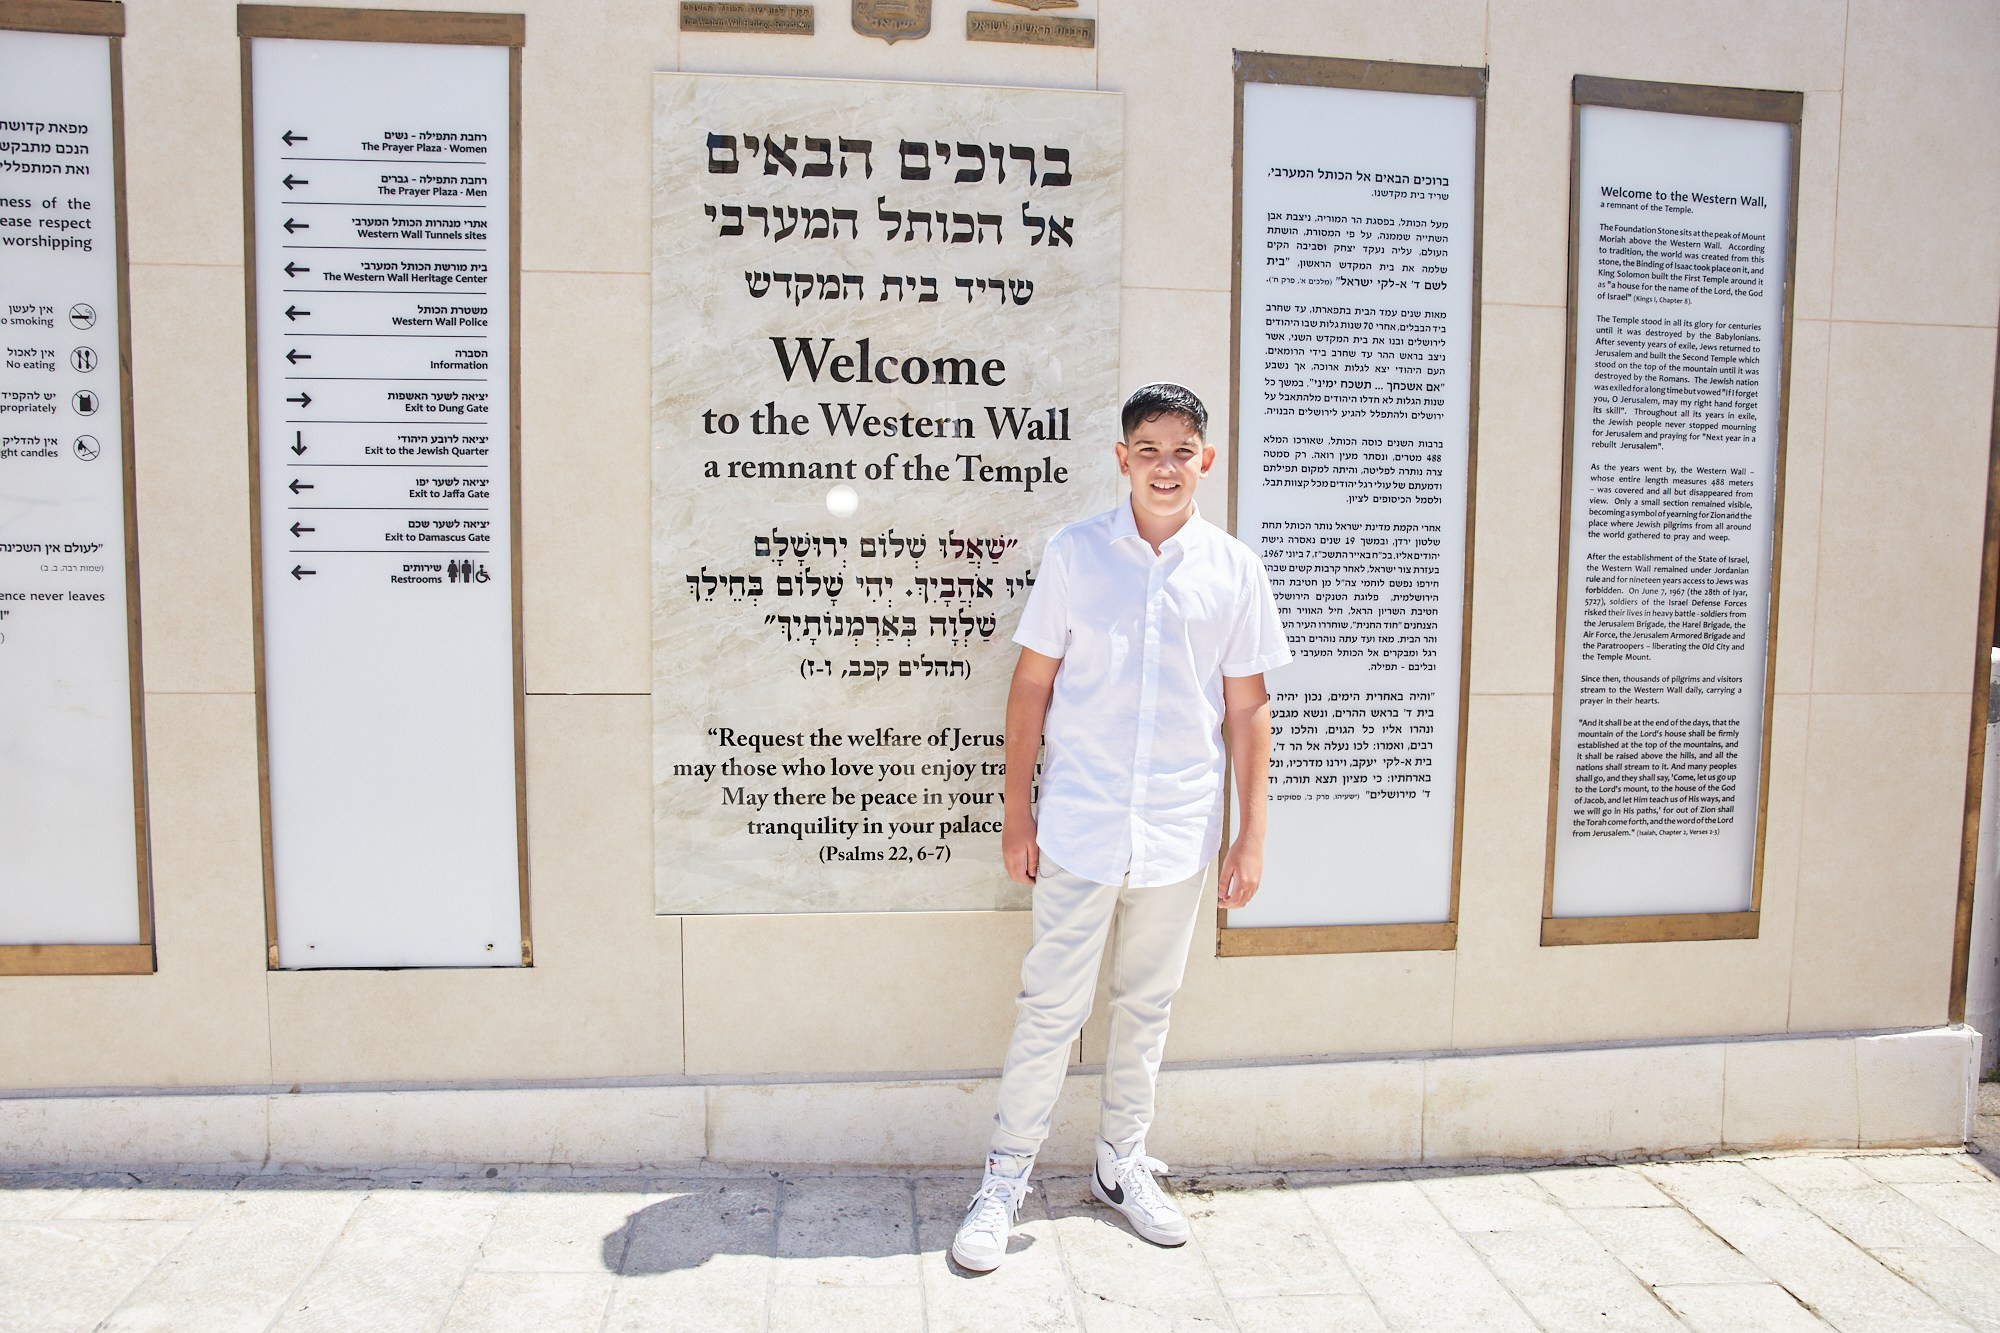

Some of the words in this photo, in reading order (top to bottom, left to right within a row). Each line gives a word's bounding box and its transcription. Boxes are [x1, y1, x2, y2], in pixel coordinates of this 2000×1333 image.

[972, 19, 1010, 32] לישראל
[1012, 22, 1051, 34] הראשית
[48, 123, 88, 134] מפאת
[56, 144, 88, 154] הנכם
[706, 132, 872, 179] הבאים
[899, 139, 1072, 188] ברוכים
[65, 165, 89, 175] ואת
[1318, 168, 1352, 180] הכותל
[1357, 170, 1371, 181] אל
[1375, 174, 1409, 183] הבאים
[1414, 176, 1449, 186] ברוכים
[1601, 186, 1652, 199] Welcome
[1656, 191, 1667, 200] to
[1670, 191, 1688, 202] the
[1692, 193, 1737, 205] Western
[42, 197, 57, 208] of
[68, 198, 90, 210] the
[39, 219, 91, 231] respect
[352, 218, 389, 227] המערבי
[392, 217, 422, 227] הכותל
[425, 220, 461, 228] מנהרות
[464, 220, 487, 228] אתרי
[704, 203, 858, 243] המערבי
[878, 195, 1002, 245] הכותל
[1022, 201, 1074, 247] אל
[357, 230, 398, 238] Western
[401, 230, 422, 238] Wall
[425, 231, 462, 239] Tunnels
[465, 231, 486, 240] sites
[3, 235, 92, 252] worshipping
[361, 263, 398, 271] המערבי
[401, 261, 431, 271] הכותל
[470, 264, 487, 272] בית
[323, 272, 341, 281] The
[343, 273, 384, 281] Western
[387, 273, 408, 282] Wall
[411, 274, 453, 285] Heritage
[455, 274, 487, 283] Center
[745, 271, 864, 307] המקדש
[880, 274, 938, 303] בית
[955, 276, 1033, 305] שריד
[9, 304, 35, 315] לעשן
[39, 306, 53, 315] אין
[418, 305, 447, 314] הכותל
[451, 307, 488, 315] משטרת
[10, 317, 54, 328] smoking
[392, 317, 433, 325] Western
[435, 317, 456, 326] Wall
[459, 318, 488, 326] Police
[7, 347, 37, 356] לאכול
[41, 350, 54, 359] אין
[455, 350, 488, 358] הסברה
[7, 360, 20, 368] No
[23, 361, 55, 372] eating
[431, 360, 488, 369] Information
[769, 337, 1005, 386] Welcome
[2, 391, 40, 402] להקפיד
[1299, 407, 1337, 416] לירושלים
[1341, 409, 1366, 417] להגיע
[1370, 410, 1407, 418] ולהתפלל
[1412, 411, 1444, 419] ירושלים
[702, 409, 739, 434] to
[750, 401, 809, 435] the
[818, 403, 975, 438] Western
[984, 407, 1071, 440] Wall
[3, 436, 40, 447] להדליק
[44, 438, 57, 447] אין
[431, 434, 459, 444] לרובע
[1592, 440, 1616, 448] rebuilt
[21, 449, 58, 457] candles
[365, 446, 383, 454] Exit
[398, 446, 414, 455] the
[417, 446, 449, 455] Jewish
[452, 447, 489, 457] Quarter
[705, 461, 720, 478] a
[728, 459, 857, 479] remnant
[865, 453, 899, 480] of
[902, 454, 949, 481] the
[956, 454, 1068, 492] Temple
[1415, 495, 1441, 504] ולסמל
[45, 544, 60, 555] אין
[391, 575, 442, 583] Restrooms
[30, 593, 64, 601] never
[69, 591, 105, 601] leaves
[1597, 653, 1623, 662] Temple
[801, 659, 831, 679] ו-ז)
[841, 660, 888, 681] קכב,
[899, 654, 971, 680] (תהלים
[1672, 675, 1700, 684] pilgrims
[810, 728, 842, 746] the
[848, 728, 921, 746] welfare
[928, 728, 951, 746] of
[747, 816, 859, 840] tranquility
[863, 817, 883, 833] in
[888, 822, 934, 839] your
[940, 815, 1002, 839] palace
[820, 846, 884, 863] (Psalms
[888, 846, 913, 863] 22,
[917, 845, 950, 863] 6-7)
